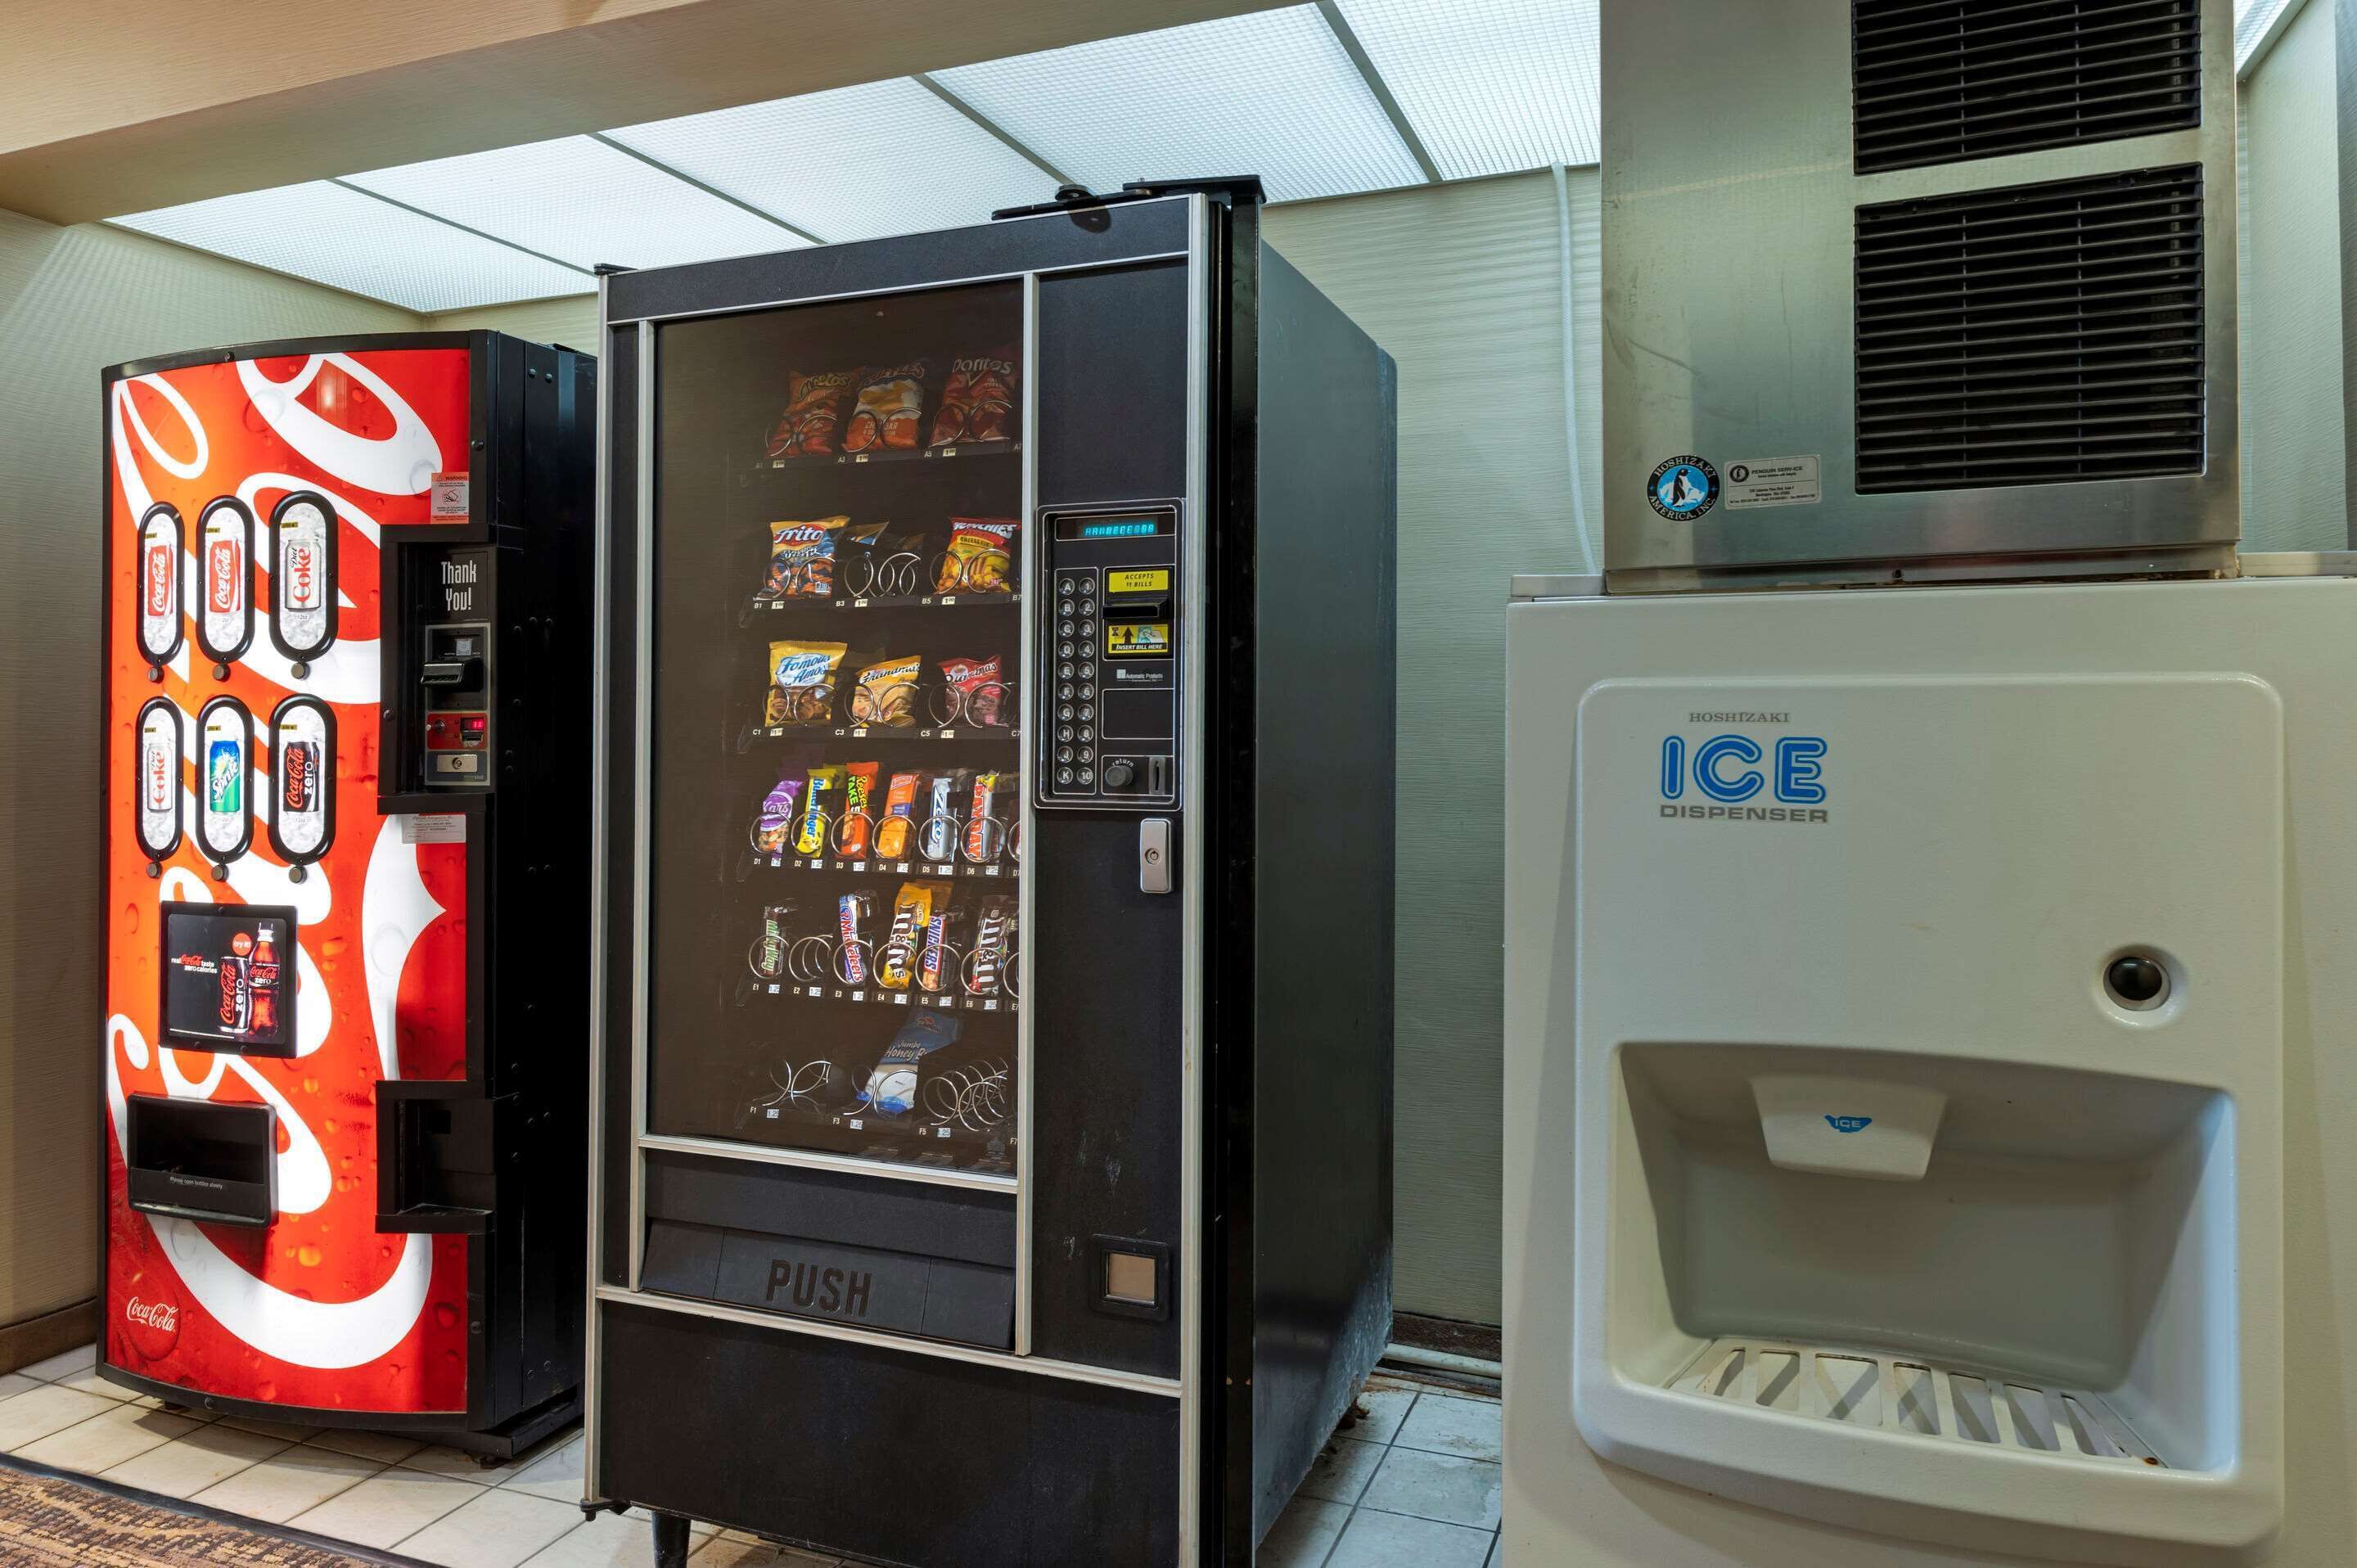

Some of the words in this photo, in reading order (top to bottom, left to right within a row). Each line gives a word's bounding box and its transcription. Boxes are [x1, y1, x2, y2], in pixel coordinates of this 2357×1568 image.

[1655, 455, 1716, 478] HOSHIZAKI
[293, 547, 311, 603] Coke
[441, 560, 477, 584] Thank
[446, 588, 472, 611] You!
[1085, 624, 1090, 633] 3
[776, 655, 831, 675] Famous
[1063, 708, 1070, 716] G
[1689, 712, 1790, 723] HOSHIZAKI
[1063, 729, 1070, 737] H
[1084, 729, 1089, 737] 8
[1084, 750, 1088, 759] 9
[1111, 758, 1134, 768] return
[153, 752, 165, 804] Coke
[304, 761, 313, 795] zero
[1661, 734, 1827, 804] ICE
[848, 776, 859, 805] TAKE
[1660, 804, 1828, 822] DISPENSER
[841, 907, 852, 918] 3
[841, 919, 864, 982] Musketeers
[925, 915, 943, 971] SNICKERS
[236, 979, 244, 1012] zero
[885, 1047, 914, 1061] Honey
[1835, 1120, 1860, 1128] ICE
[766, 1259, 872, 1317] PUSH
